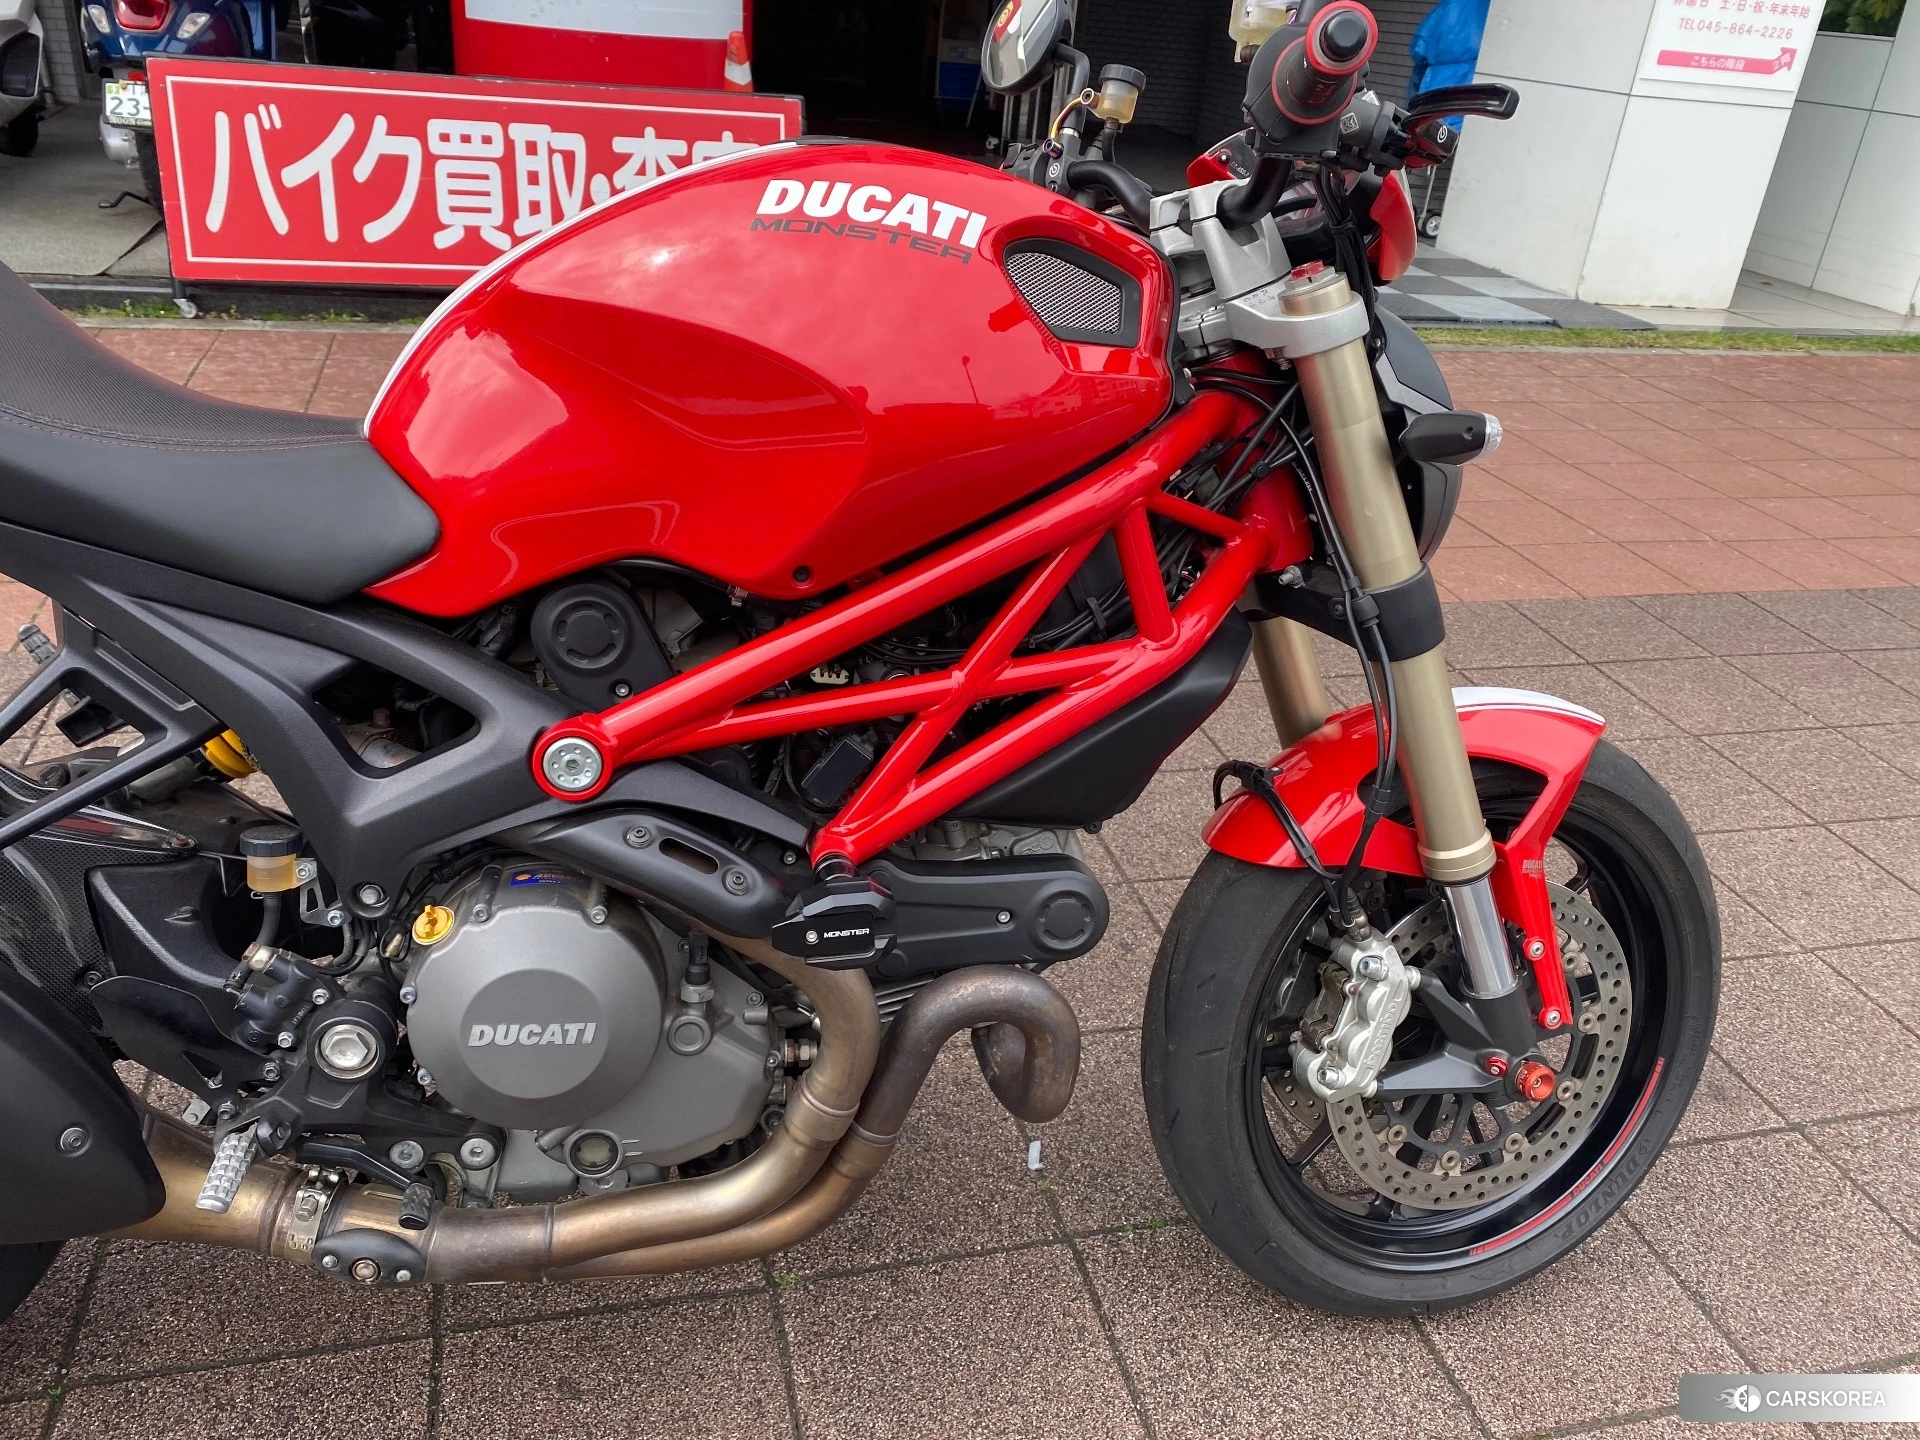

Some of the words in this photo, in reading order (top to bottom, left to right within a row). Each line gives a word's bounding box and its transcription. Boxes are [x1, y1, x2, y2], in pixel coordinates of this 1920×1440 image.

[756, 179, 987, 249] DUCATI
[750, 217, 972, 265] MONSTER
[823, 928, 870, 938] MONSTER
[468, 1022, 597, 1047] DUCATI
[1362, 1002, 1398, 1068] brembo
[1559, 1155, 1640, 1241] DUNLOP
[1572, 1163, 1604, 1198] DUCATI
